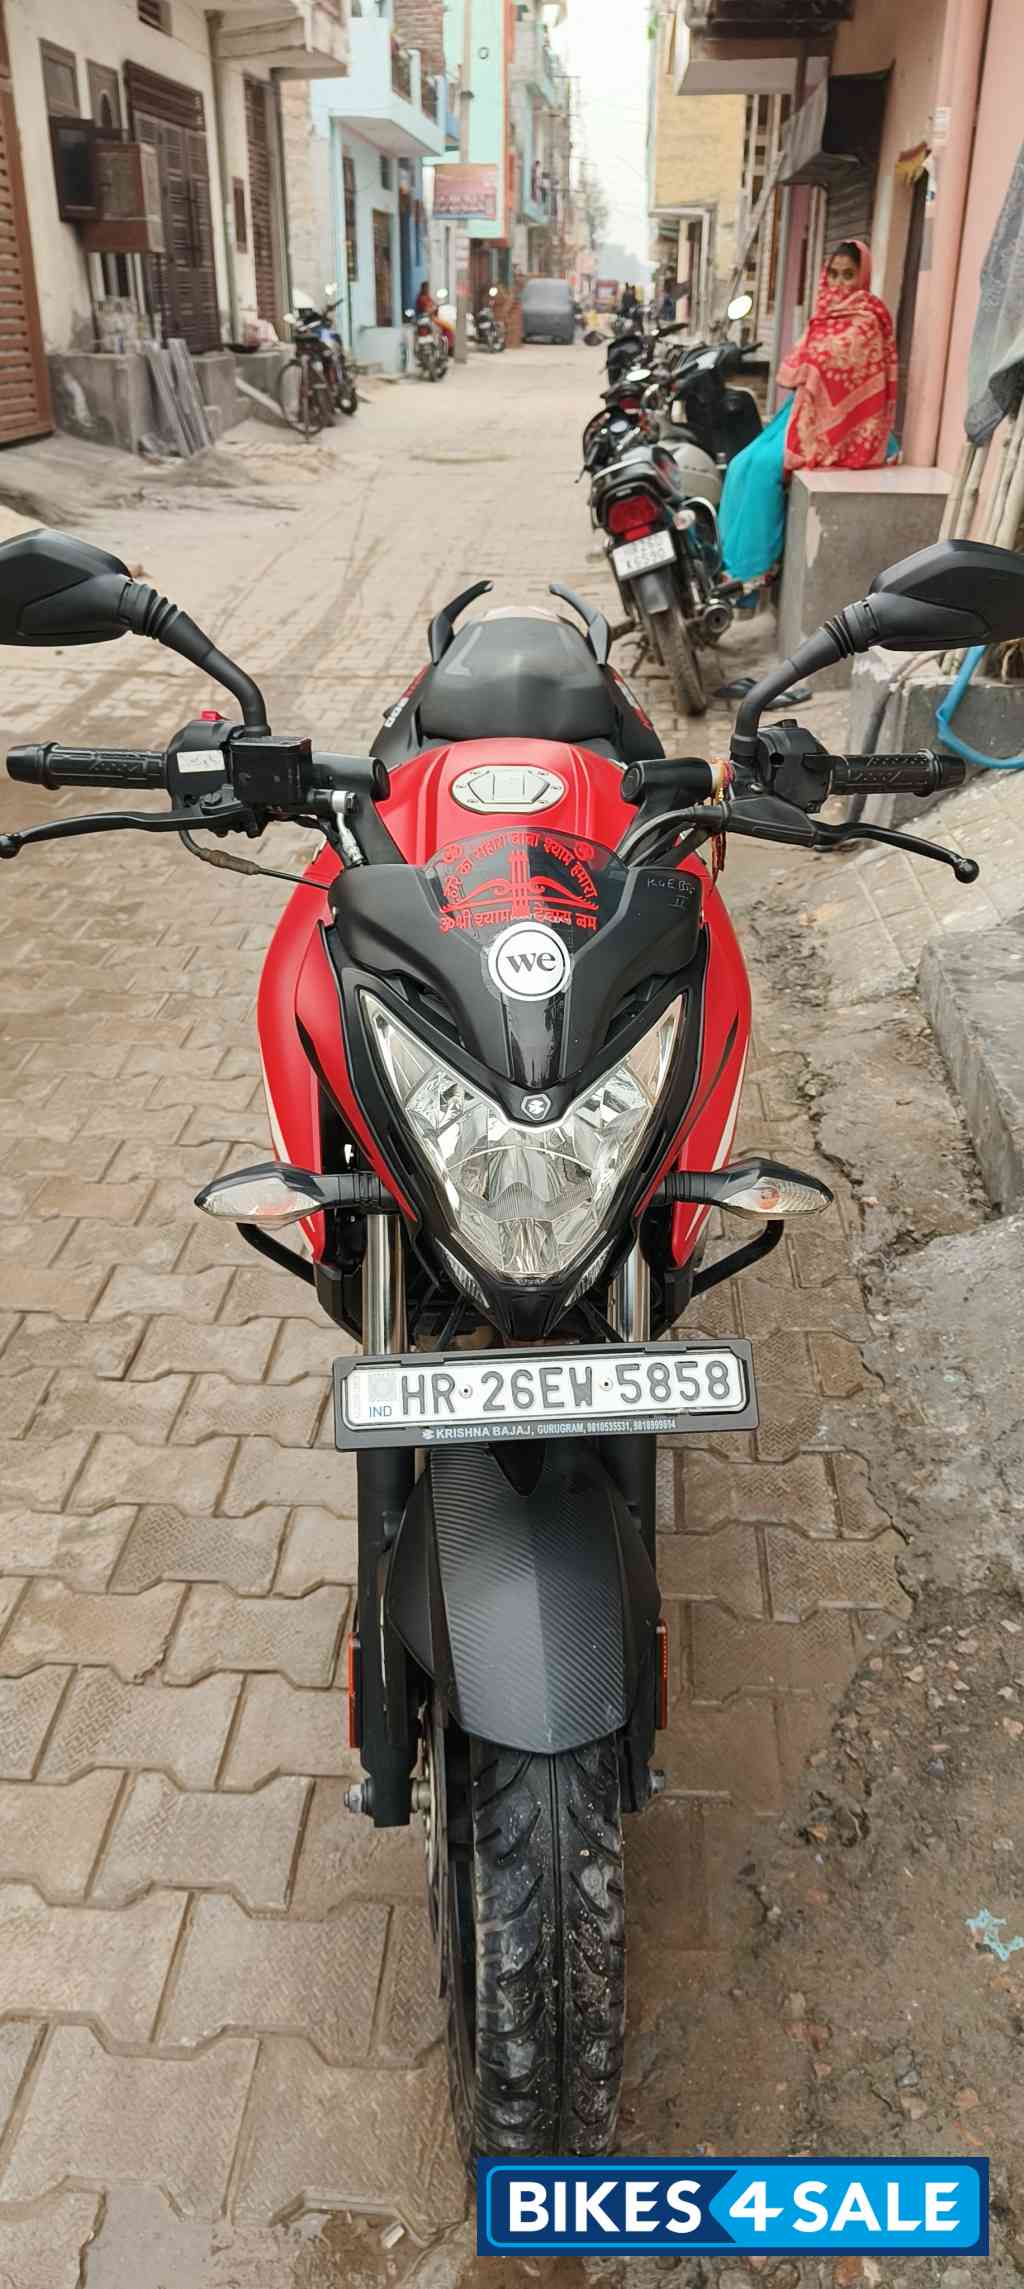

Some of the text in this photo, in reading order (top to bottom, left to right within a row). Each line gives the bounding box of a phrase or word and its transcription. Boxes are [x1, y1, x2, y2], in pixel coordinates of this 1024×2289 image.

[506, 952, 556, 973] we
[401, 1373, 455, 1416] HR
[481, 1366, 593, 1412] 26EW
[615, 1360, 730, 1404] 5858
[368, 1405, 393, 1418] IND
[436, 1428, 490, 1440] KRISHNA
[492, 1425, 535, 1437] BAJAJ,
